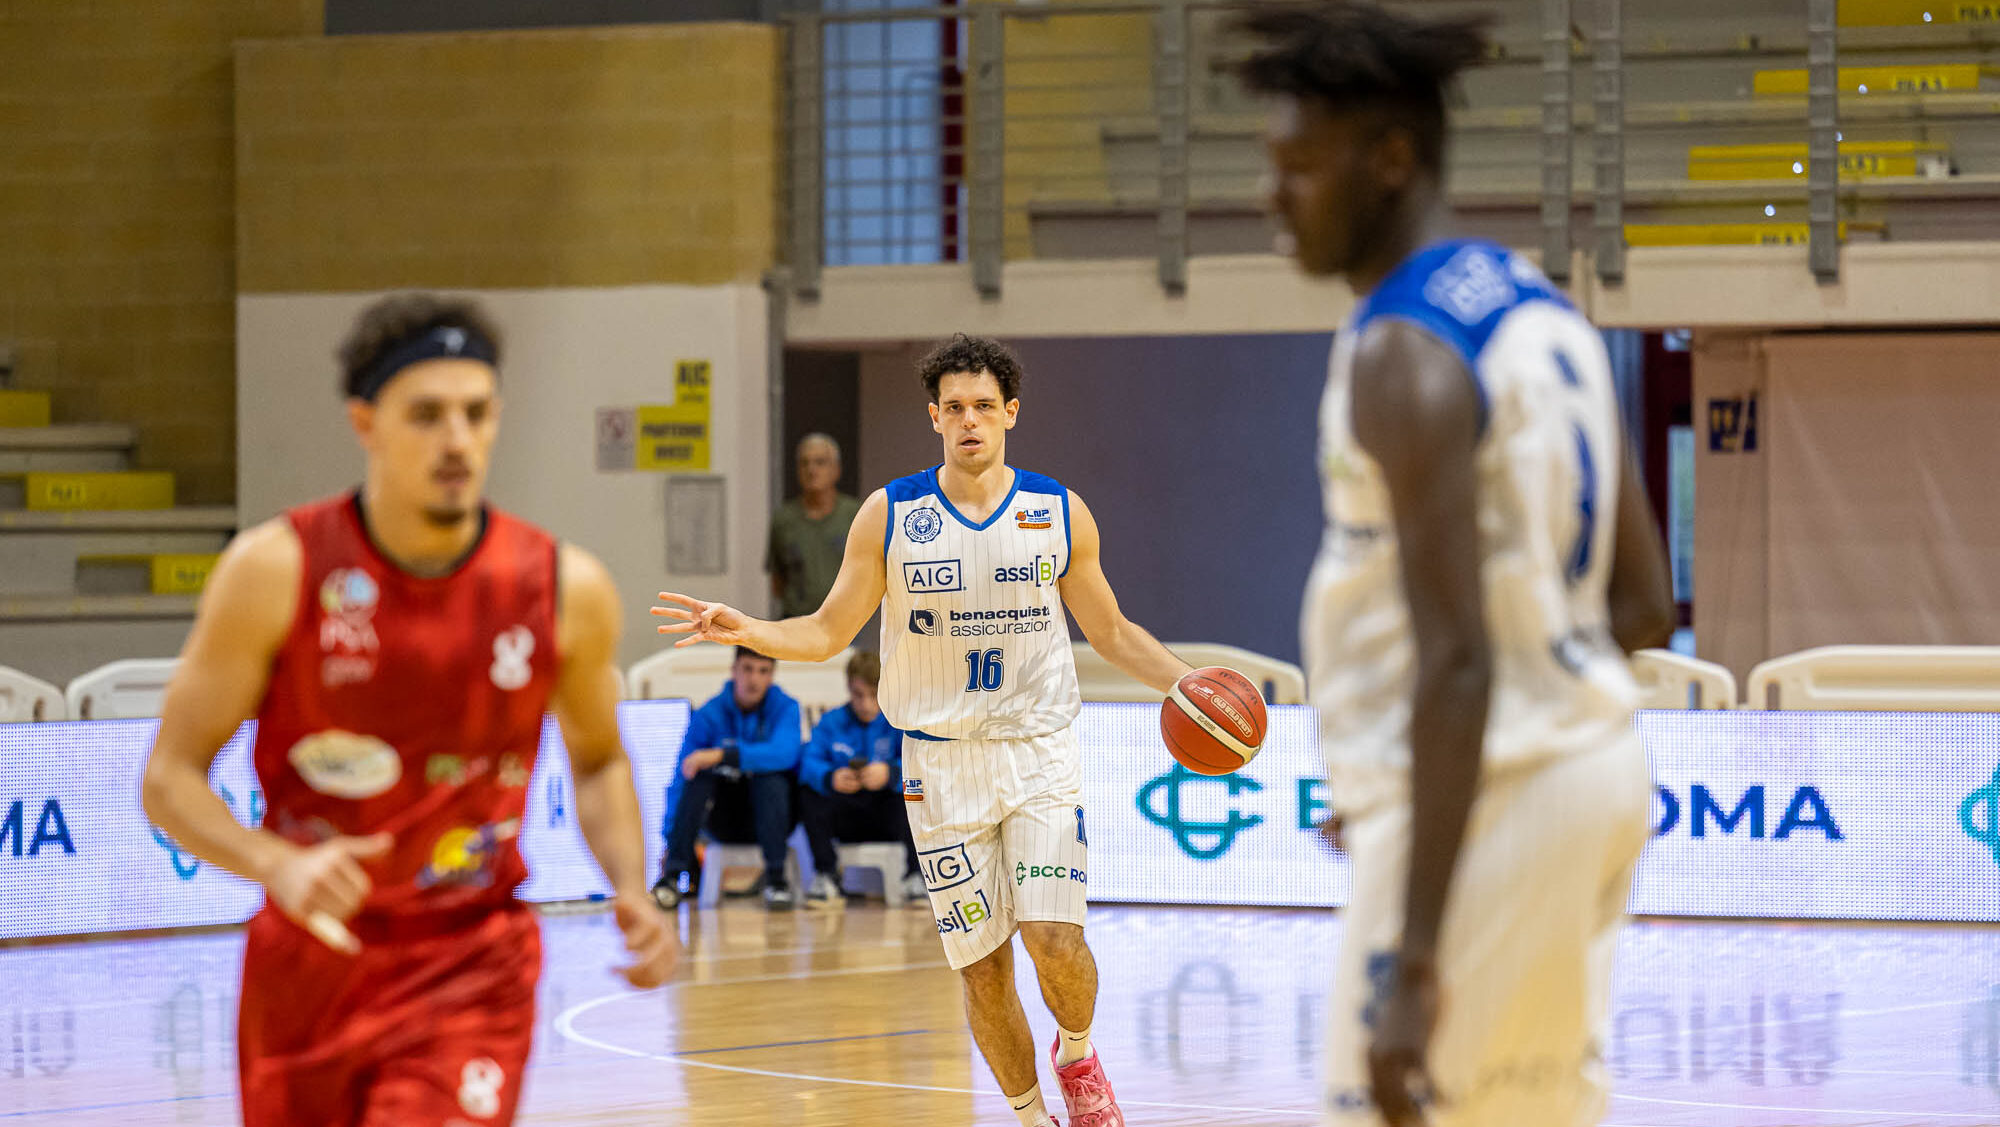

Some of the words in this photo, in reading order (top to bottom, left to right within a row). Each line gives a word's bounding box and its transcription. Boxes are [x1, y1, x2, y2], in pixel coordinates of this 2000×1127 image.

[1025, 509, 1049, 517] LNP
[911, 565, 954, 587] AIG
[965, 648, 1004, 692] 16
[1213, 697, 1226, 709] OLD
[1030, 865, 1066, 879] BCC
